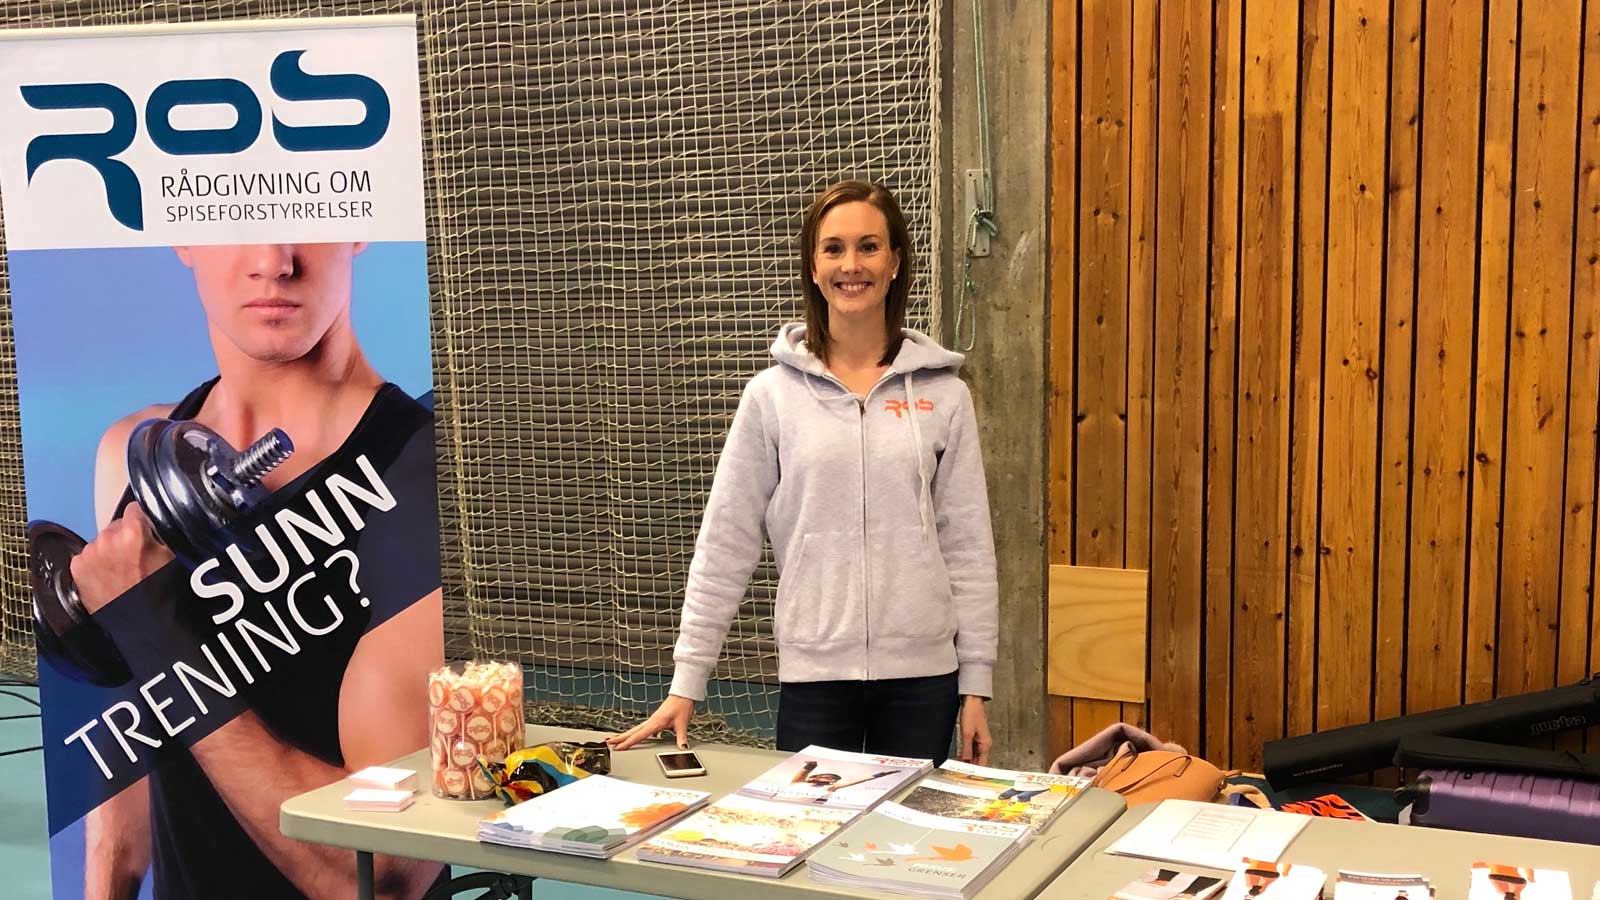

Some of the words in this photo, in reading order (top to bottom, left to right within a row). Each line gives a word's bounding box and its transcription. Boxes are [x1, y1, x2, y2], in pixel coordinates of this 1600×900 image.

[19, 49, 391, 231] ROS
[161, 168, 321, 198] RÅDGIVNING
[329, 169, 371, 194] OM
[165, 200, 374, 223] SPISEFORSTYRRELSER
[190, 454, 397, 625] SUNN
[64, 549, 370, 780] TRENING?
[907, 866, 968, 880] GRENSER
